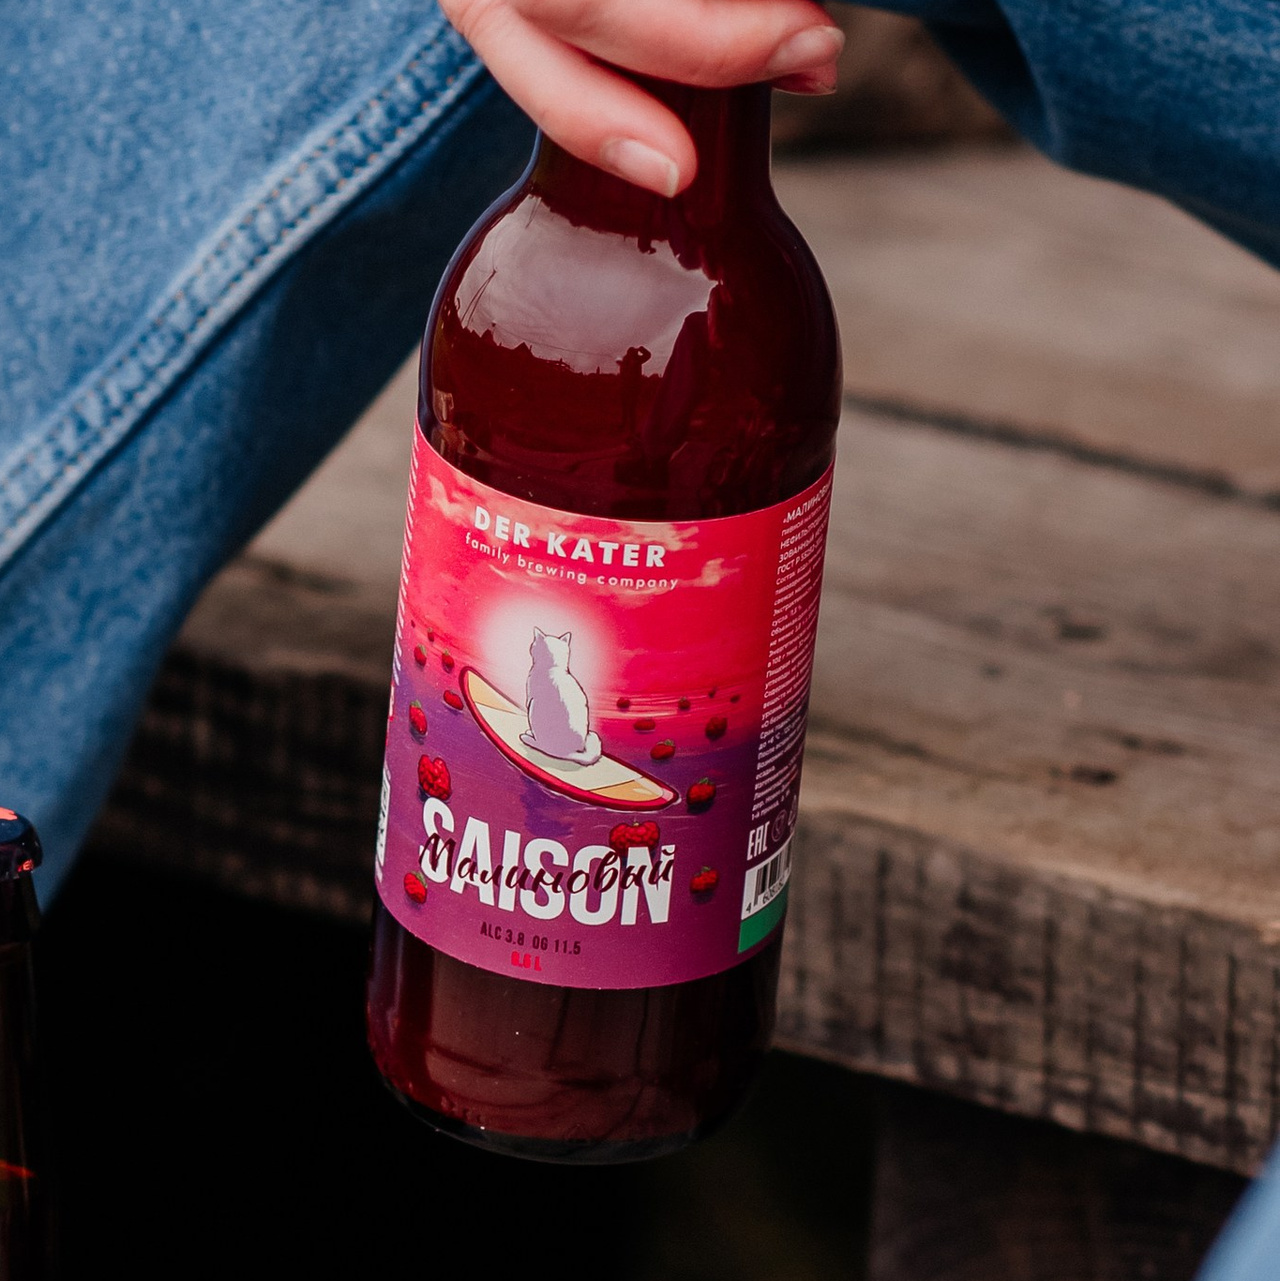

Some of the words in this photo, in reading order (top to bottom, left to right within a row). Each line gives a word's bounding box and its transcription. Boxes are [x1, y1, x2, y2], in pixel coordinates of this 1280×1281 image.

[465, 532, 511, 566] family
[517, 554, 587, 584] brewing
[597, 574, 679, 590] company
[474, 505, 531, 549] DER
[547, 532, 666, 568] KATER
[418, 832, 676, 895] Малиновый
[419, 797, 676, 926] SAISON
[480, 921, 503, 940] ALC
[505, 929, 525, 946] 3.8
[554, 939, 581, 955] 11.5
